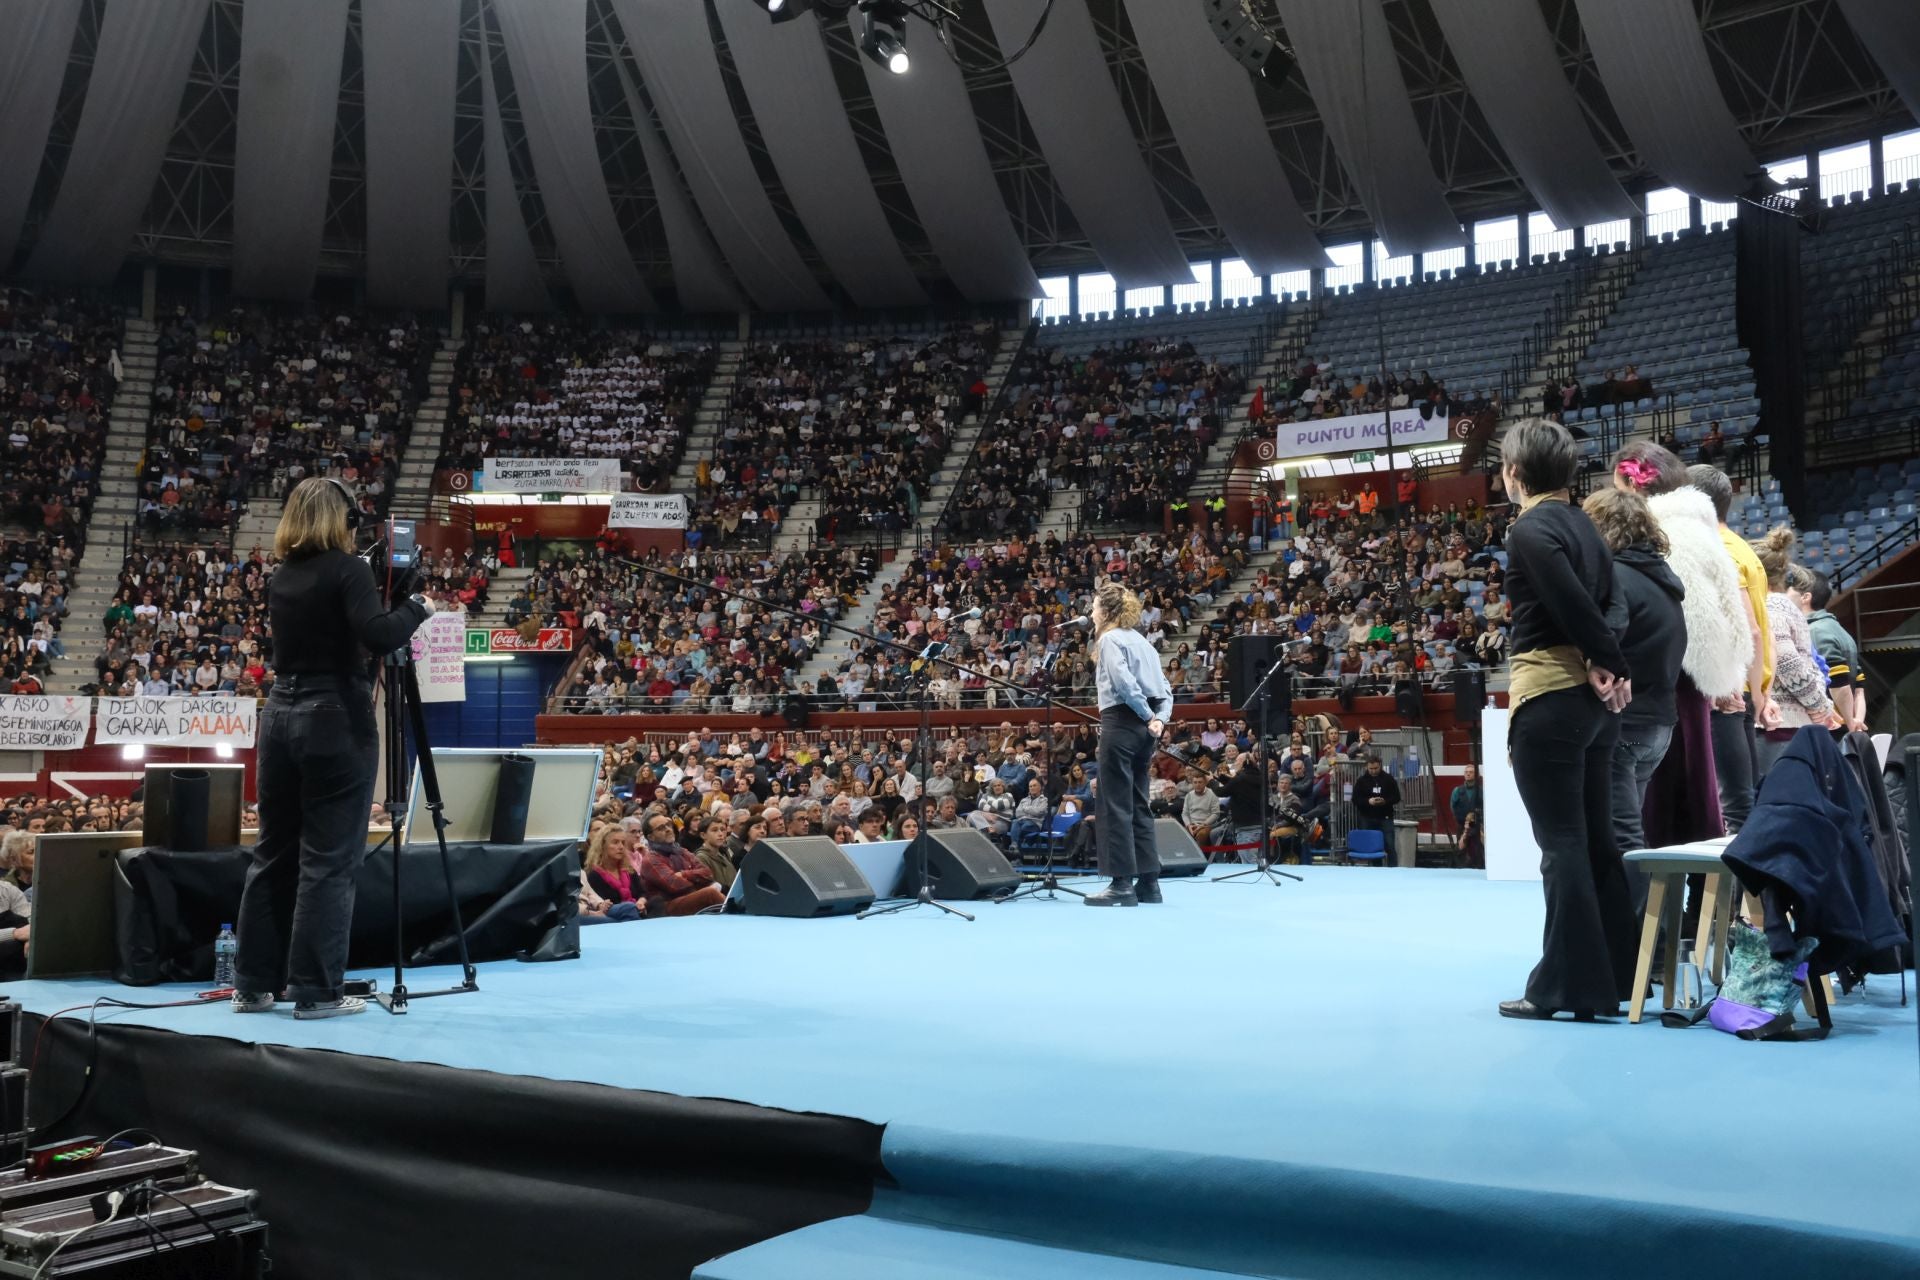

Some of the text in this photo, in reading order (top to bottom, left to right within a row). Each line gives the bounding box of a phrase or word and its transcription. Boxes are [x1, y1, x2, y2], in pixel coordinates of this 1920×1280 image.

[1297, 418, 1426, 445] PUNTU MOREA
[514, 480, 537, 488] ZUTAZ
[475, 522, 493, 530] BAR
[13, 697, 49, 712] ASKO
[110, 699, 166, 715] DENOK
[107, 716, 169, 735] GARAIA
